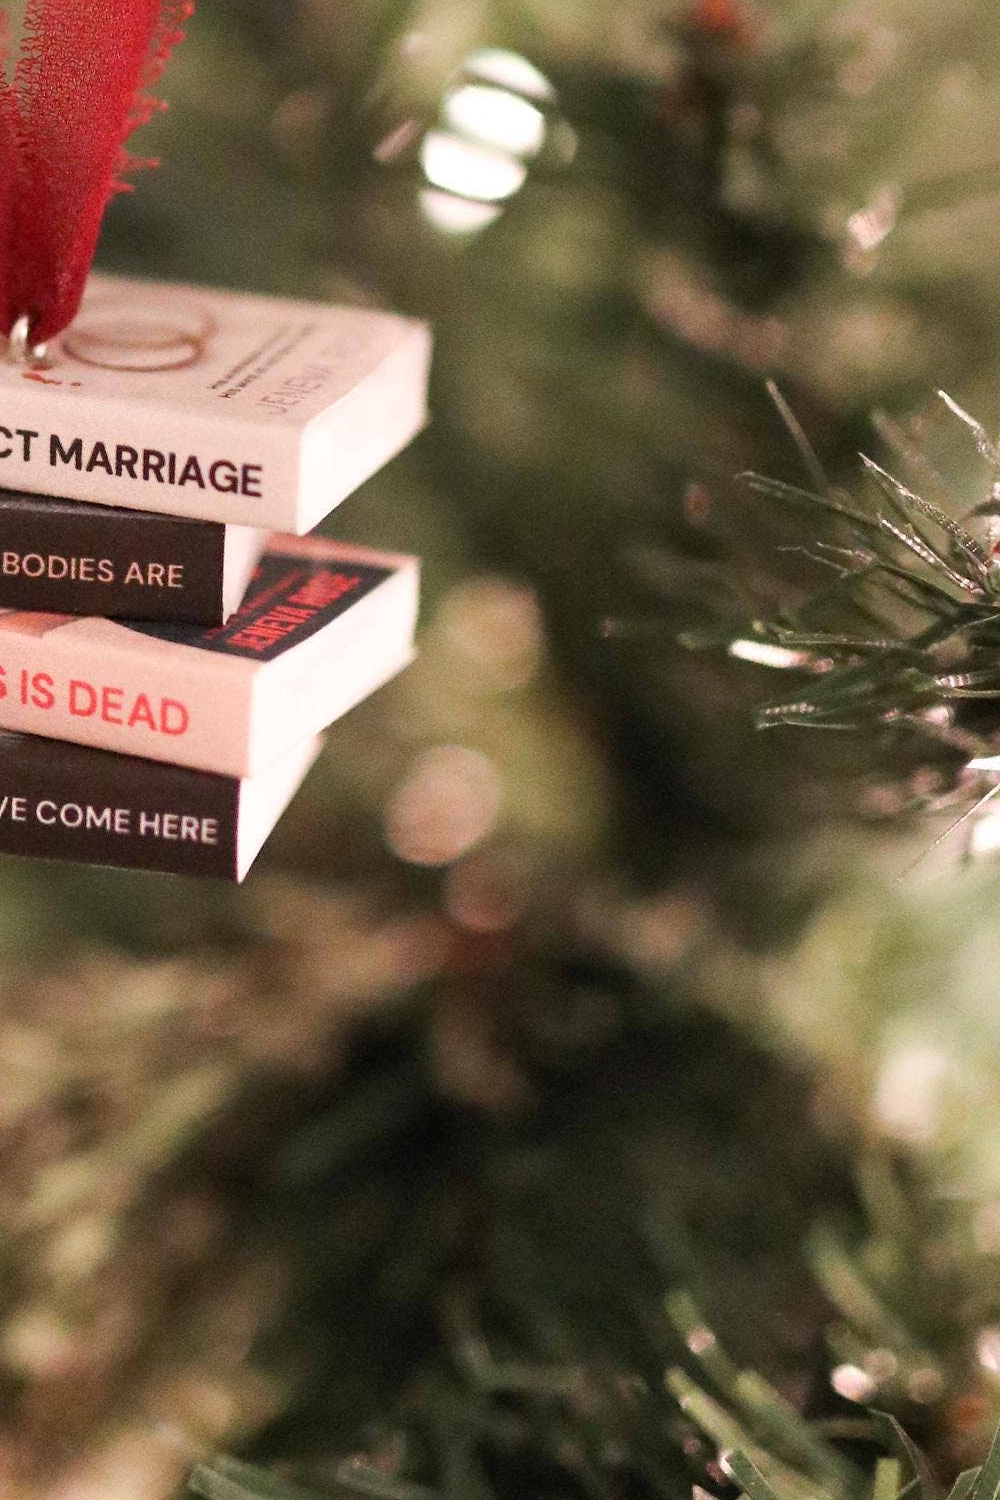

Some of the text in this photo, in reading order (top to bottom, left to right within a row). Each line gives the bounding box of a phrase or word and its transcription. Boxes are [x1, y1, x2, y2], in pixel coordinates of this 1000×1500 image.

[48, 434, 263, 498] MARRIAGE
[2, 551, 114, 583] BODIES
[125, 560, 184, 588] ARE
[20, 670, 56, 711] IS
[69, 679, 190, 736] DEAD
[36, 800, 131, 834] COME
[138, 811, 218, 845] HERE
